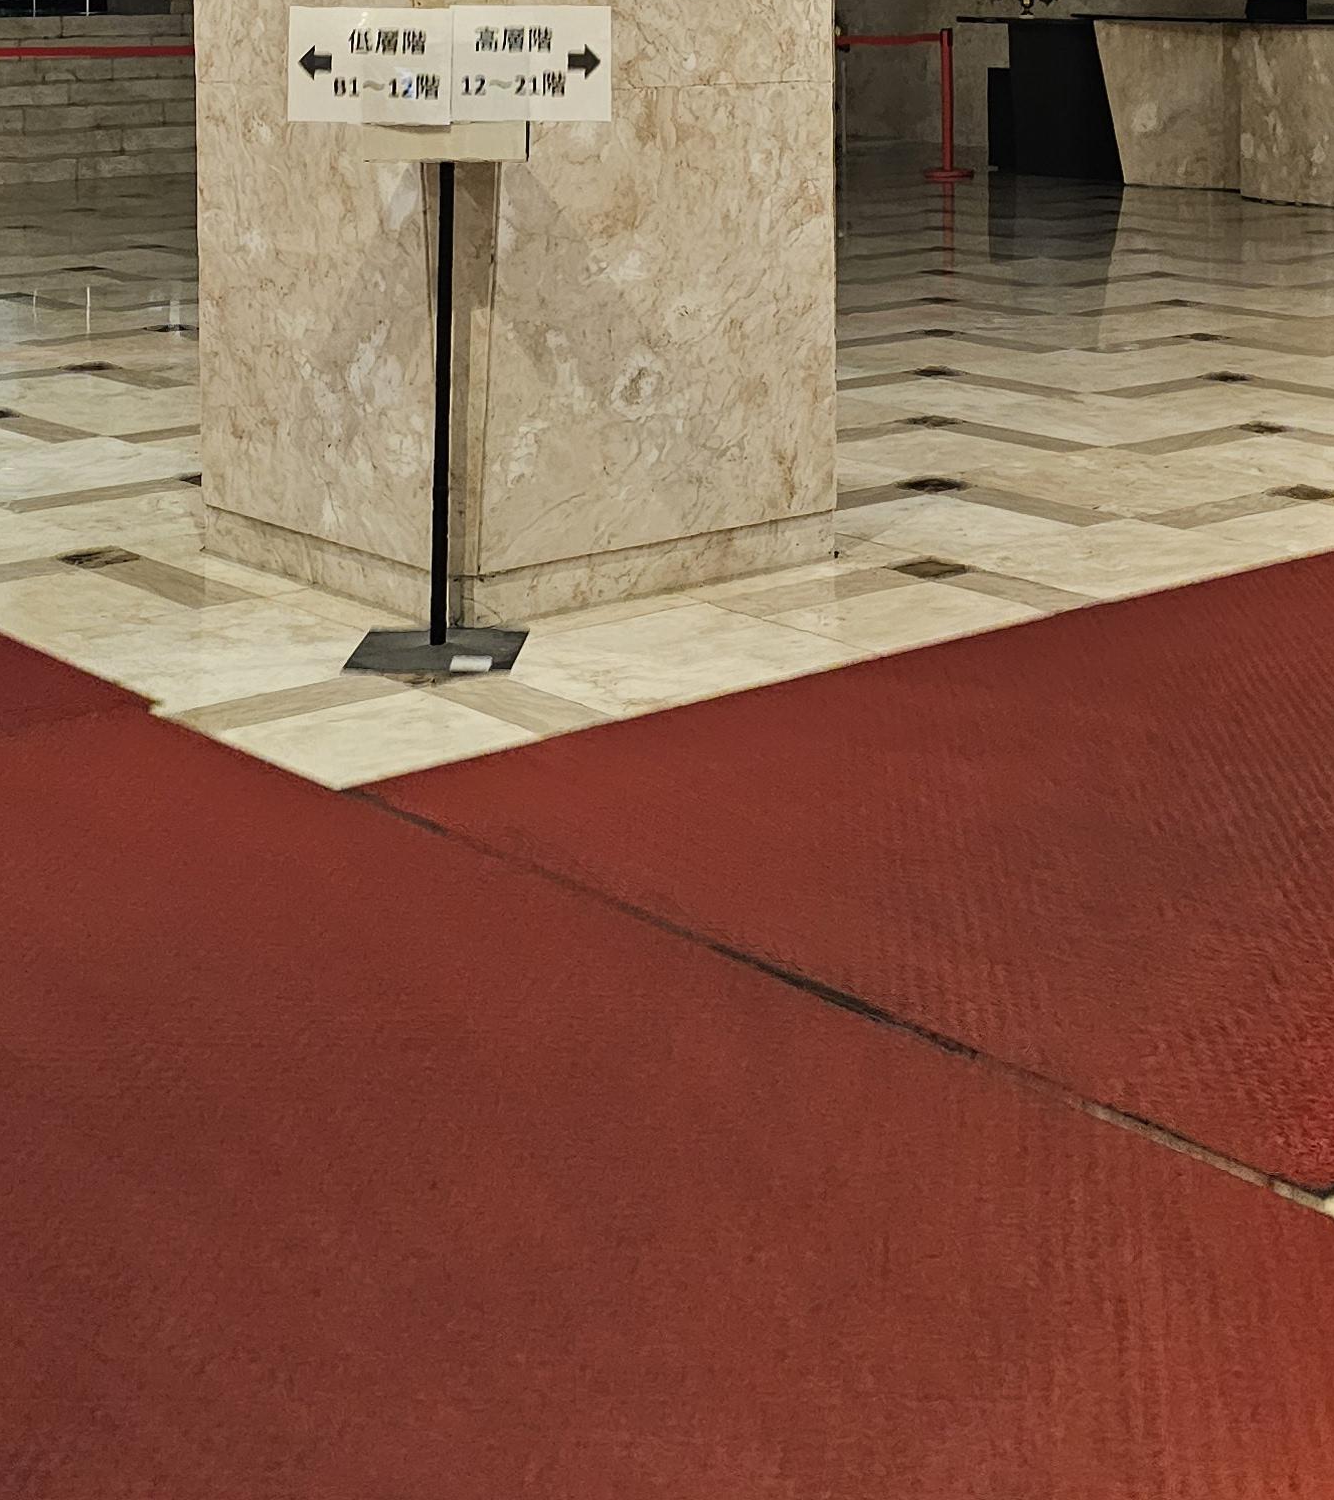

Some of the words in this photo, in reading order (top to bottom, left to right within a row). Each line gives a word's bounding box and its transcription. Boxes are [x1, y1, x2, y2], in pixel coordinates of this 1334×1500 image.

[348, 28, 427, 55] 低層階
[475, 26, 552, 53] 高層階
